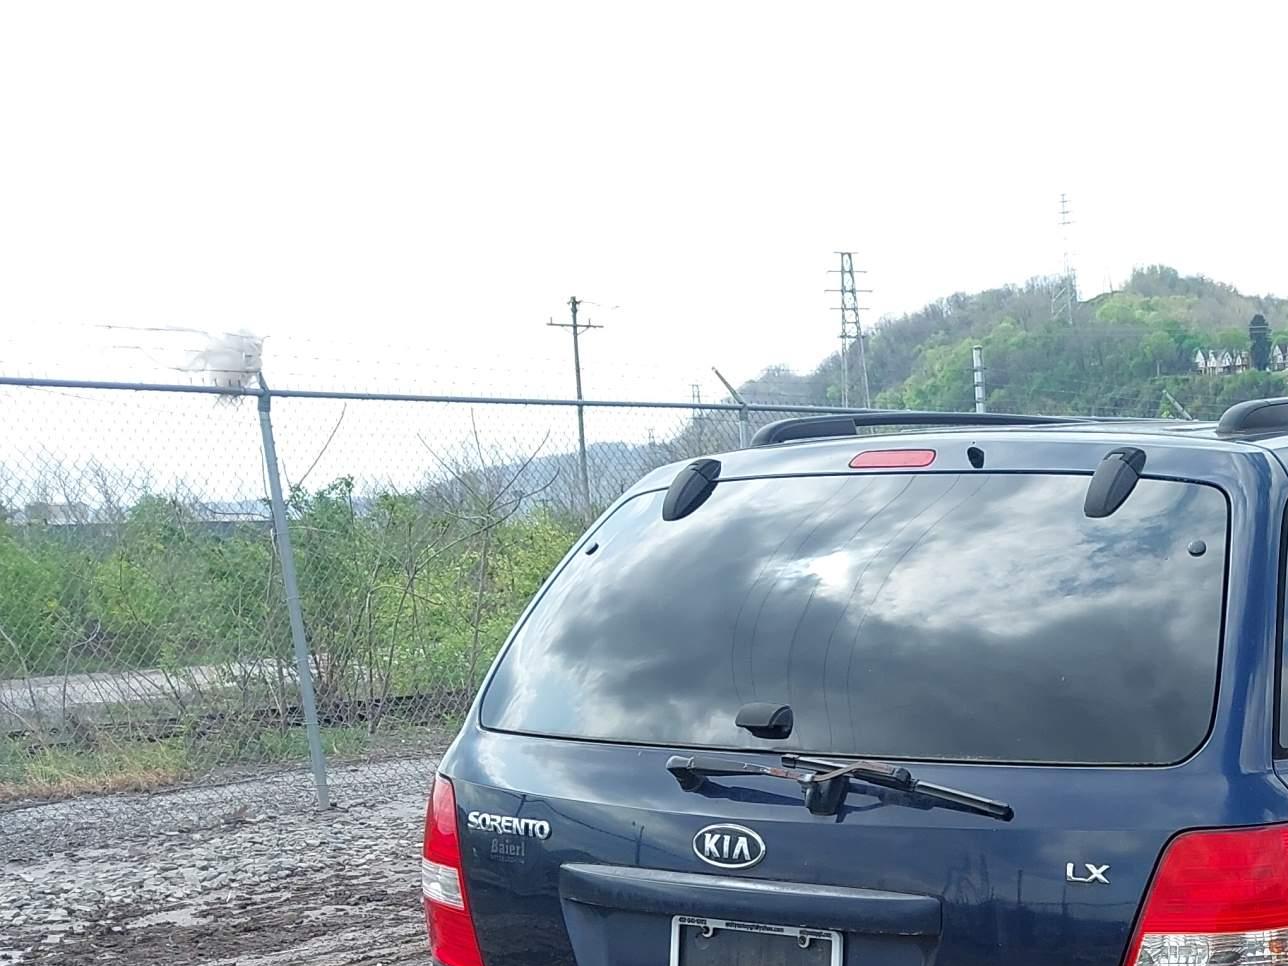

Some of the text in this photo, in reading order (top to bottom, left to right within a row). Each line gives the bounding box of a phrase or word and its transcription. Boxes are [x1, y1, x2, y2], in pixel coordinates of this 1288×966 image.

[467, 811, 551, 839] SORENTO
[490, 838, 526, 857] Baierl
[704, 833, 751, 861] KIA
[1066, 862, 1110, 884] LX
